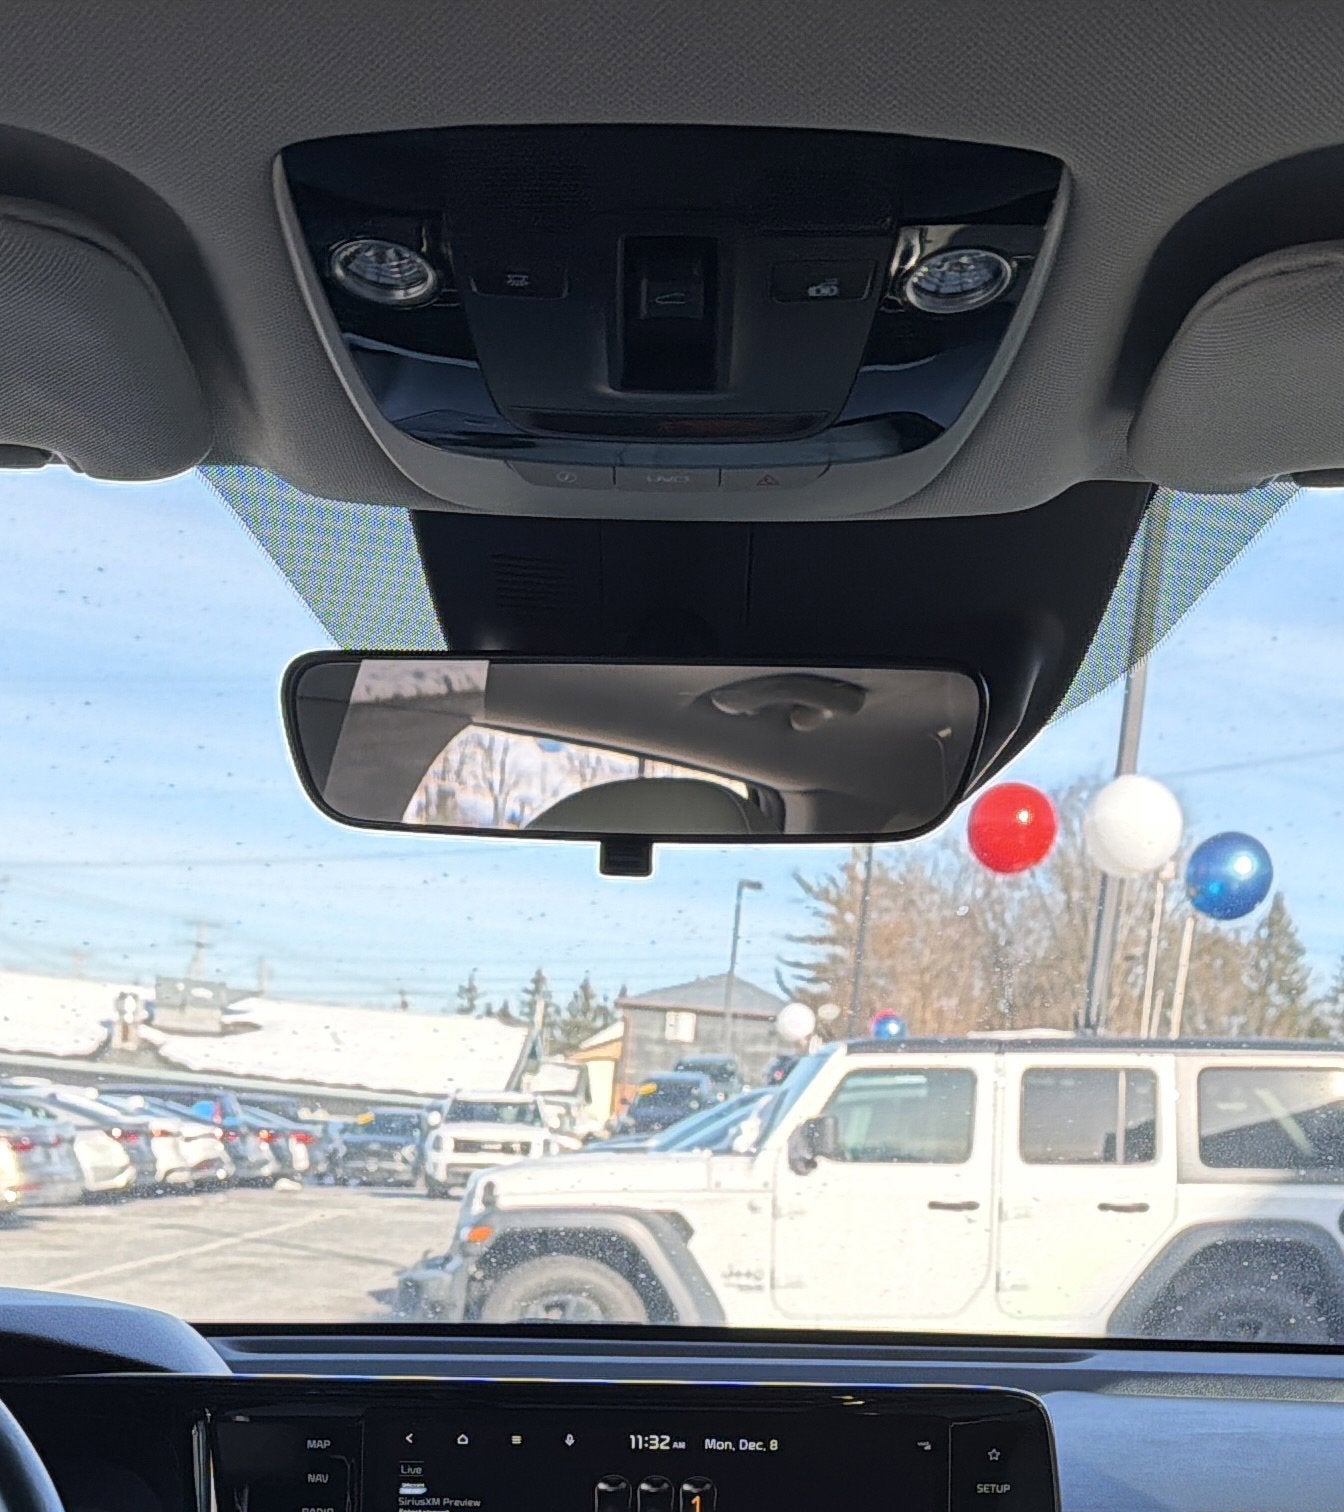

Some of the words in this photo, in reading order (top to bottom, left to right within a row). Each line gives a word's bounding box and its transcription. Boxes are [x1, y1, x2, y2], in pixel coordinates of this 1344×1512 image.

[306, 1439, 331, 1449] MAP
[629, 1434, 671, 1450] 11:32
[672, 1441, 686, 1449] AM
[769, 1439, 779, 1451] 8
[400, 1464, 423, 1475] Live
[307, 1473, 329, 1483] NAV
[976, 1483, 1011, 1494] SETUP
[398, 1497, 440, 1506] SiriusXM
[442, 1498, 481, 1507] Preview
